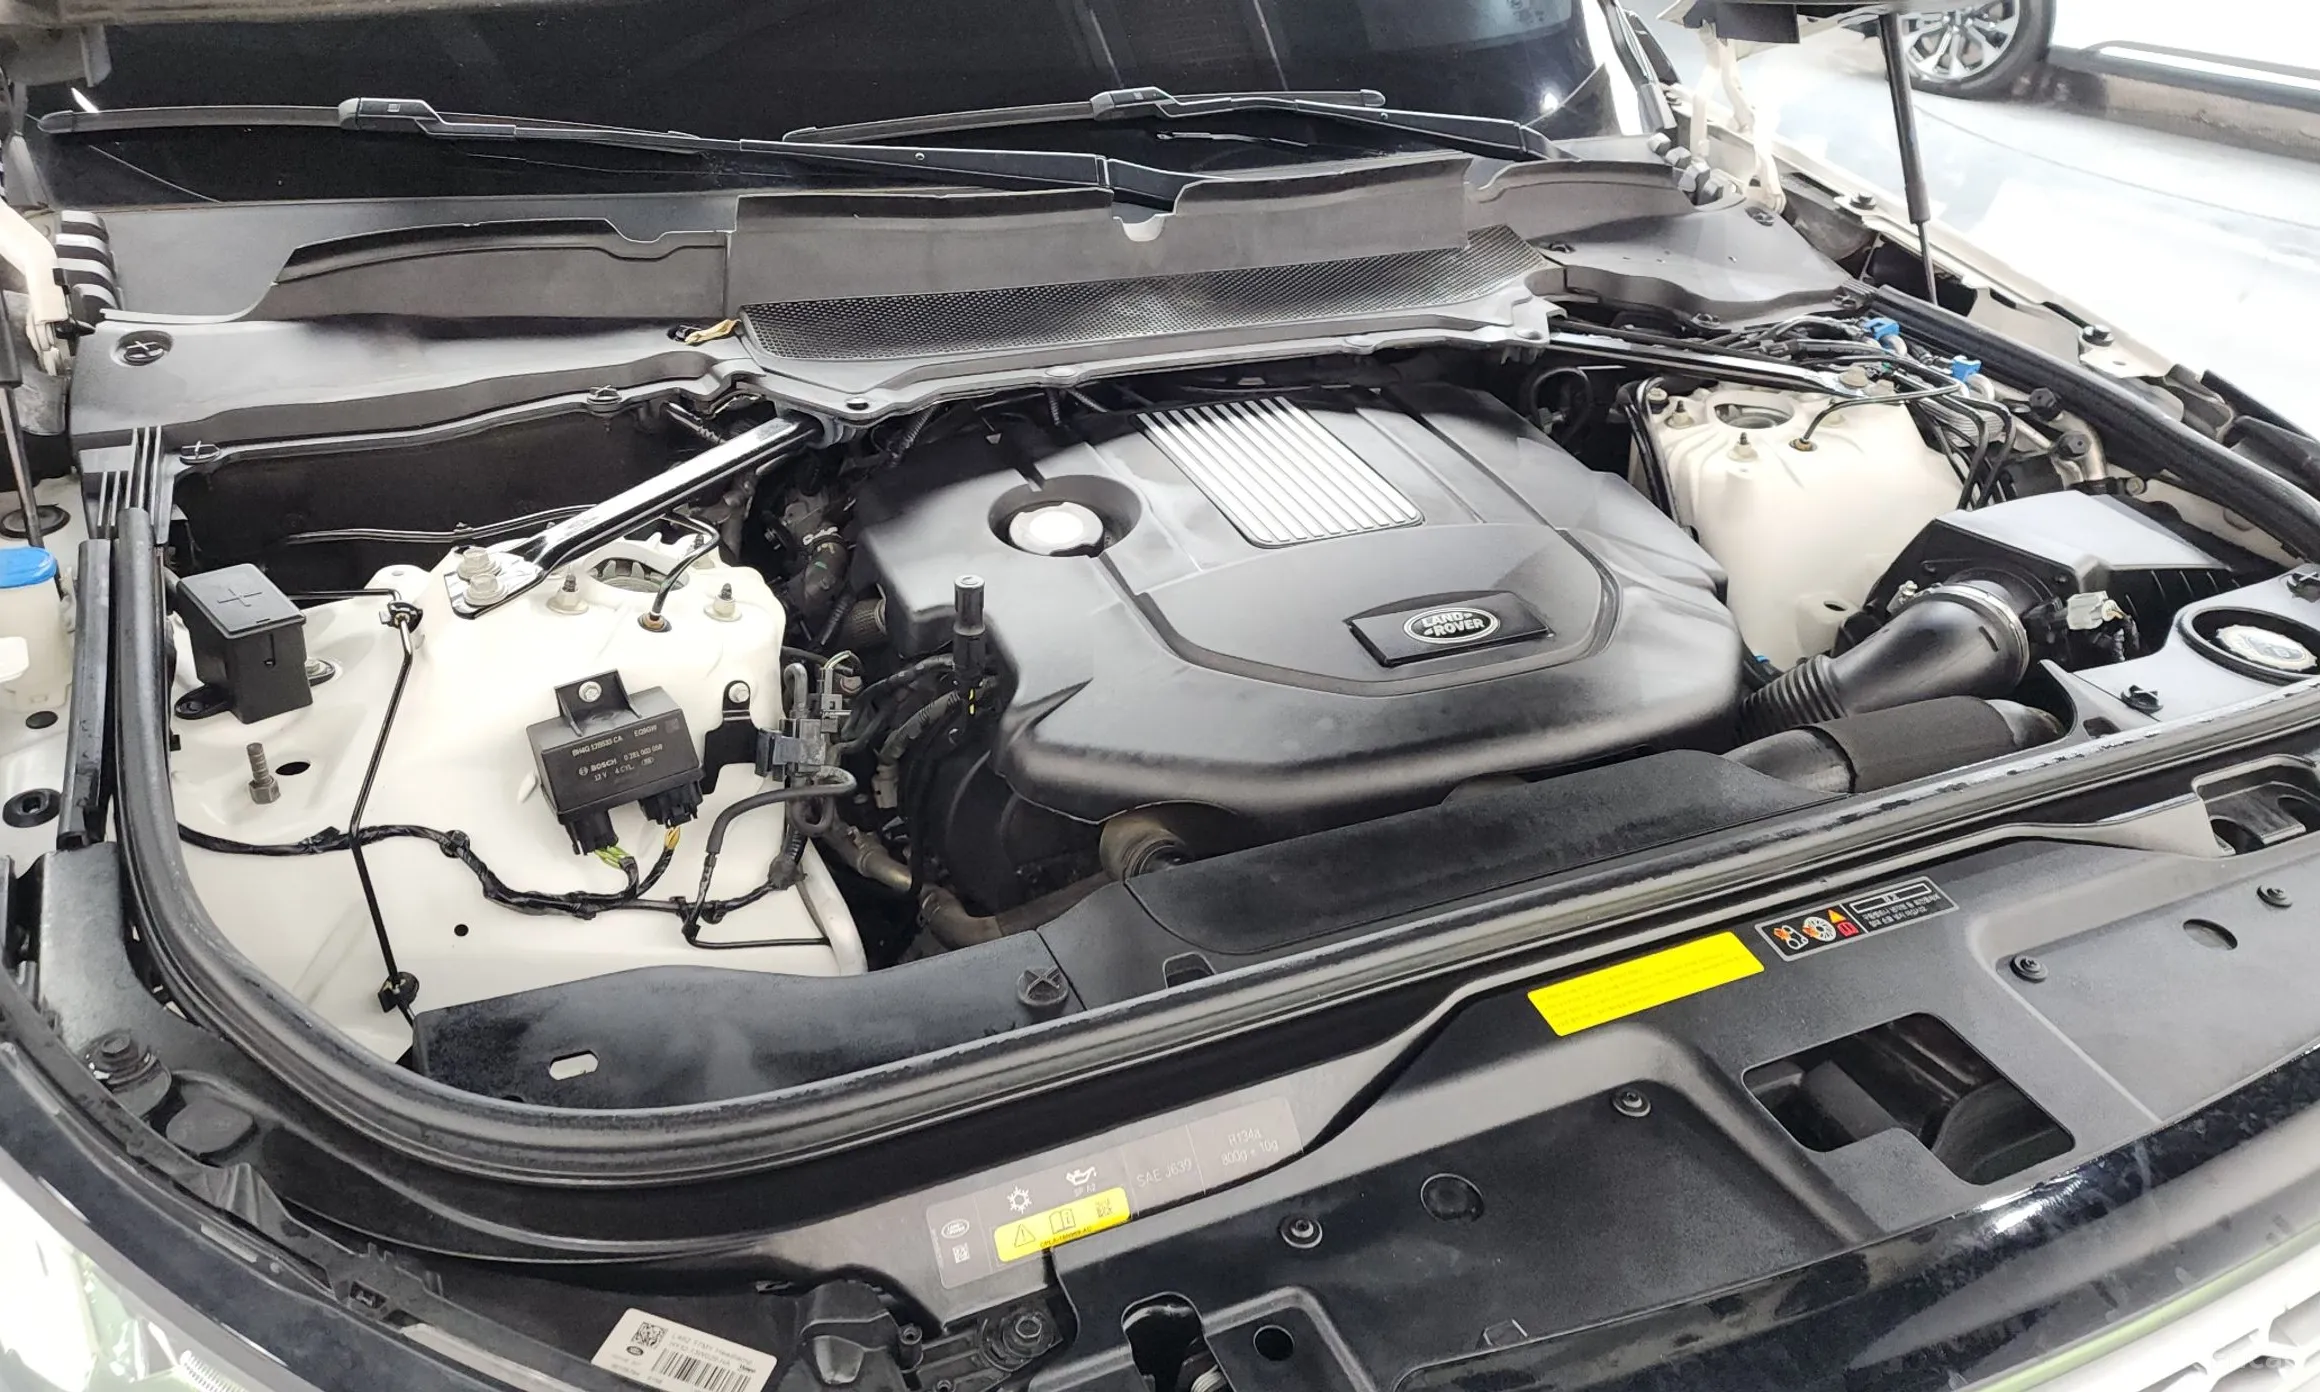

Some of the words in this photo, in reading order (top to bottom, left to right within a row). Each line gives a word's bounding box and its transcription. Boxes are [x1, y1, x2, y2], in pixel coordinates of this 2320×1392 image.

[1421, 612, 1464, 628] LAND
[1433, 618, 1485, 637] ROVER
[590, 757, 617, 772] BOSCH
[1228, 1127, 1261, 1146] R134a
[1260, 1139, 1279, 1153] 10g
[1136, 1168, 1161, 1188] SAE
[1165, 1157, 1192, 1179] J639
